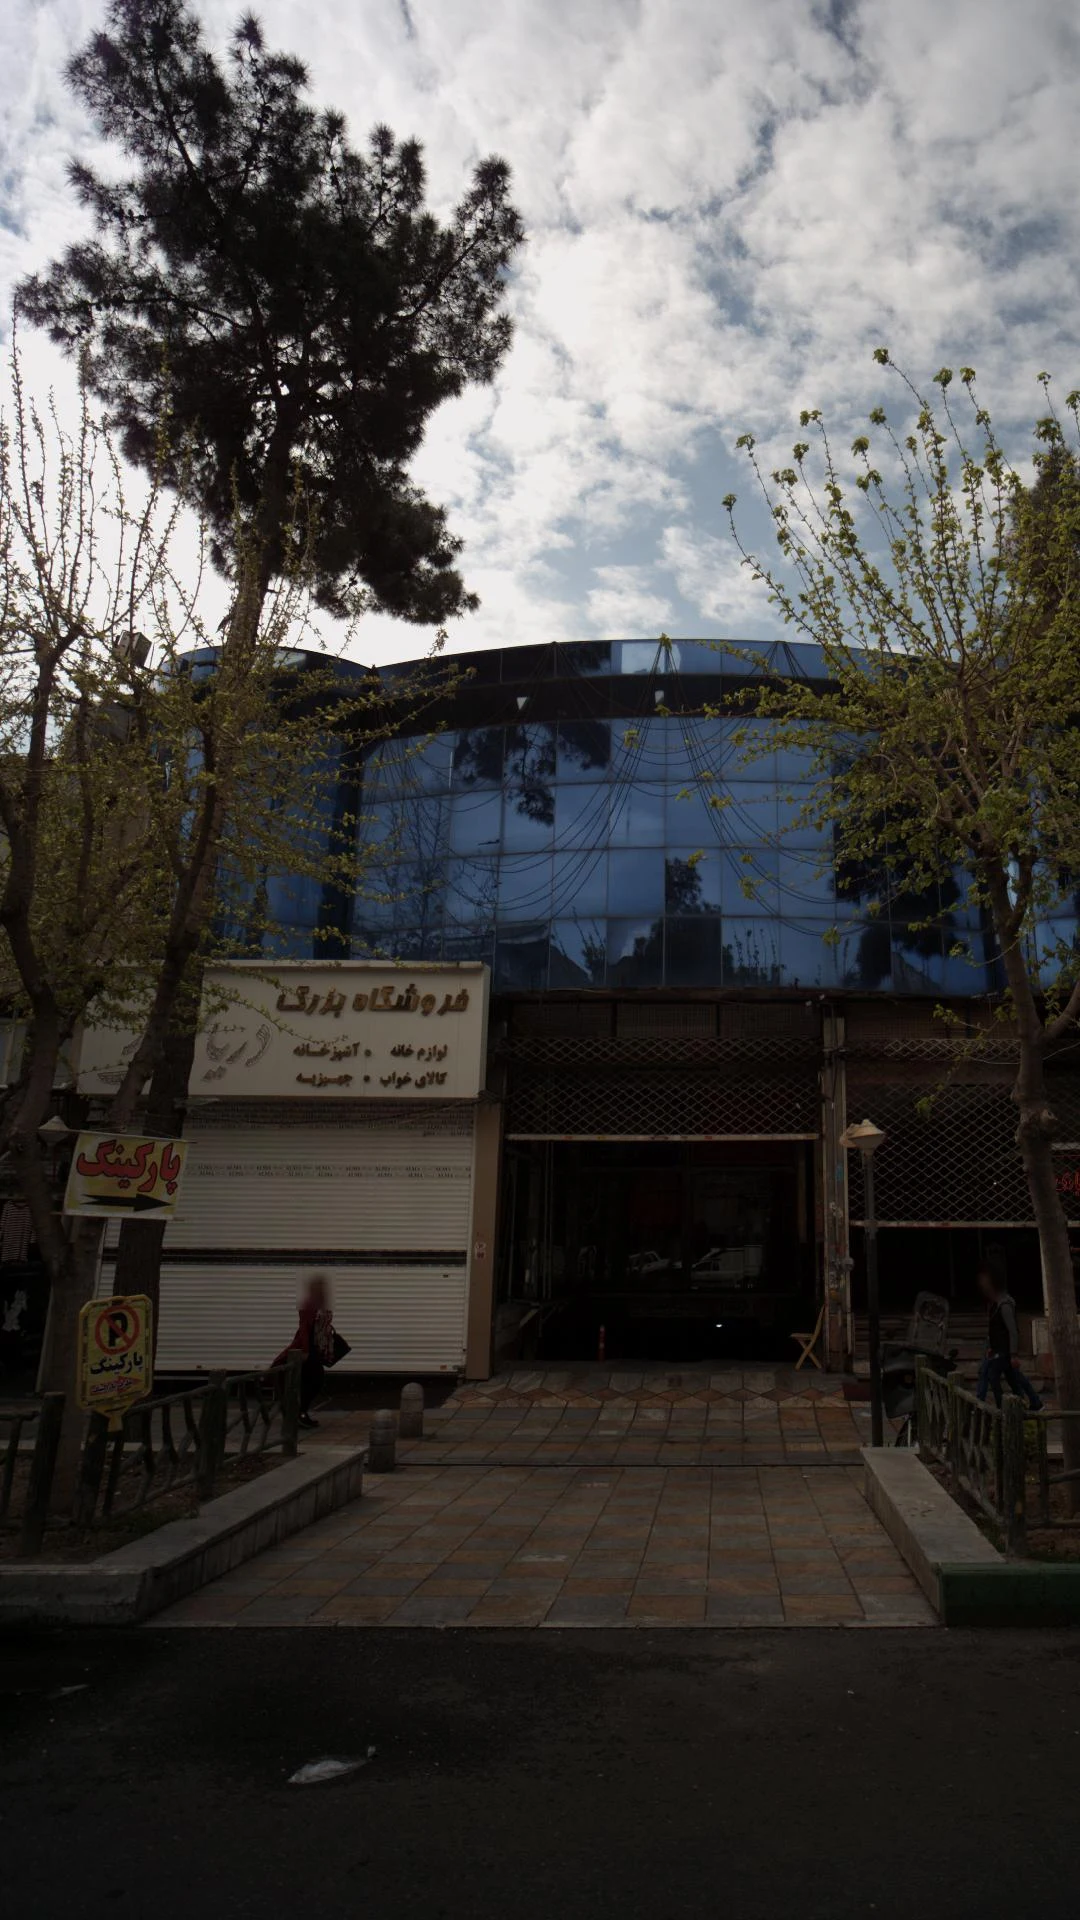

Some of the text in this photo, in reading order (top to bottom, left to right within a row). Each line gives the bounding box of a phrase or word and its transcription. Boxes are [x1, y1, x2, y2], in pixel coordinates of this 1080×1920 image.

[276, 983, 470, 1019] فروشگاه بزرگ
[390, 1044, 415, 1057] خانه
[416, 1044, 449, 1062] لوازم
[296, 1071, 448, 1089] کالای خواب جهیزیه
[76, 1139, 181, 1196] پارکینگ
[90, 1352, 143, 1375] پارکینگ
